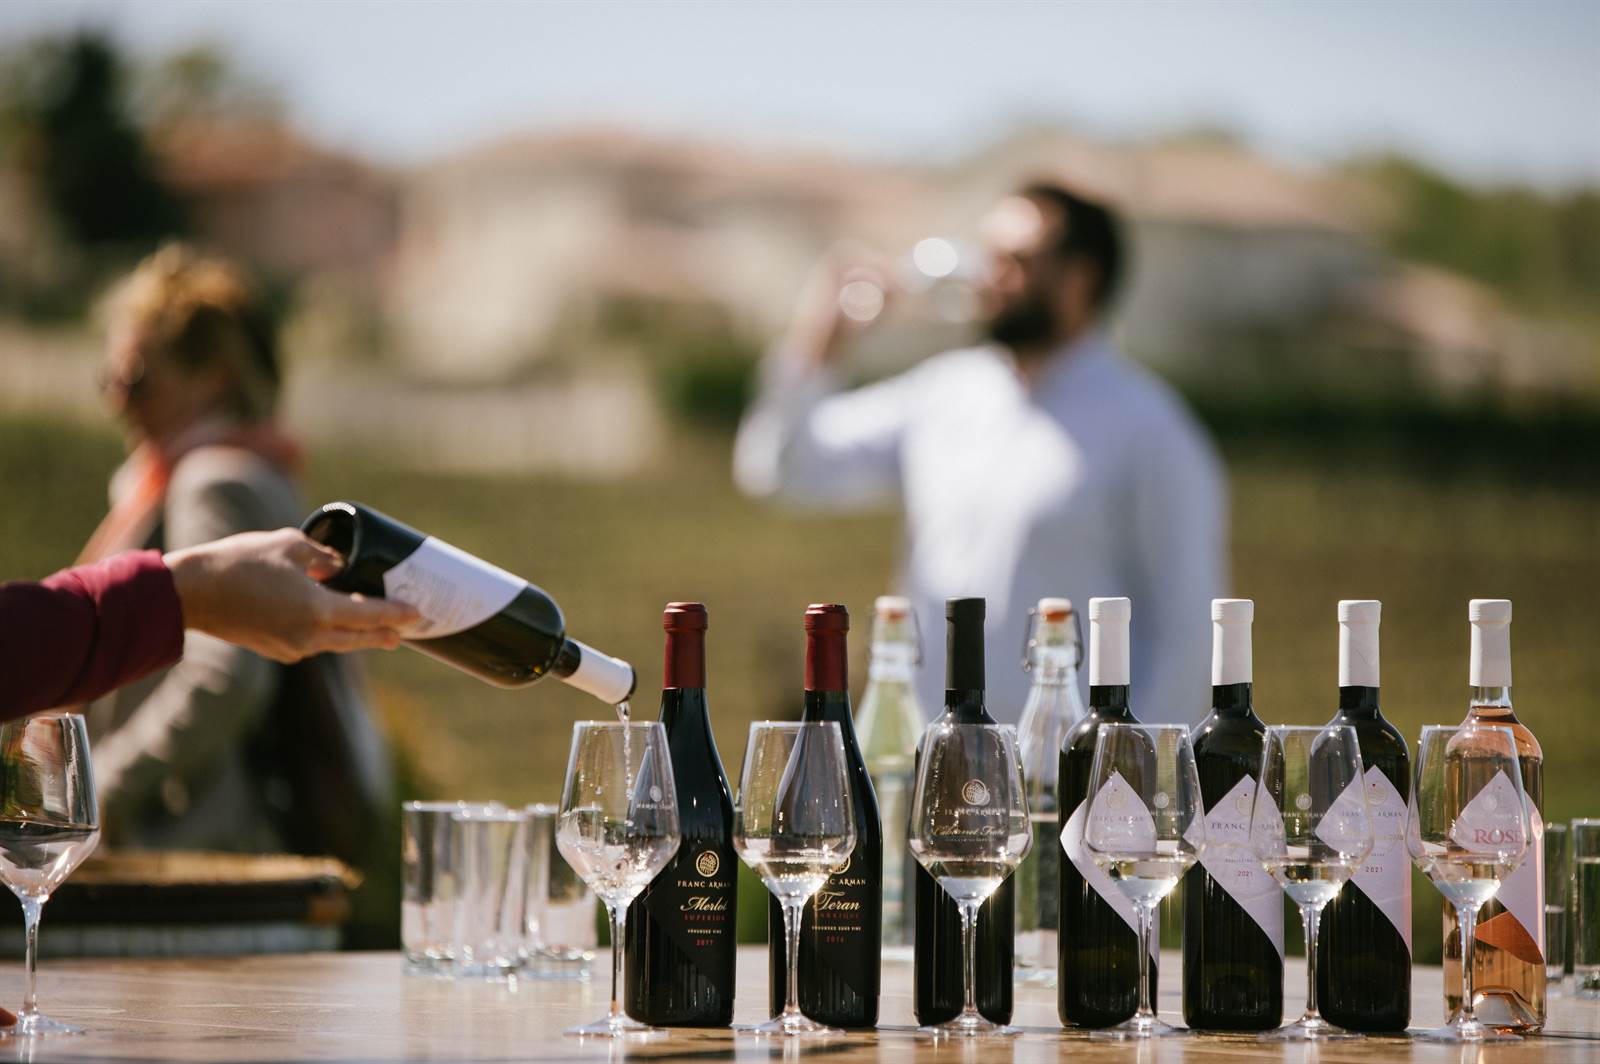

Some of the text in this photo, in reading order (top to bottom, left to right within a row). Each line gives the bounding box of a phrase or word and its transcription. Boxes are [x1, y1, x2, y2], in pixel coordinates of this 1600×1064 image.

[1211, 822, 1245, 831] FRANC
[677, 880, 706, 888] FRANC
[838, 879, 866, 887] ARMAN
[680, 896, 729, 911] Merlot
[815, 891, 860, 911] Teran
